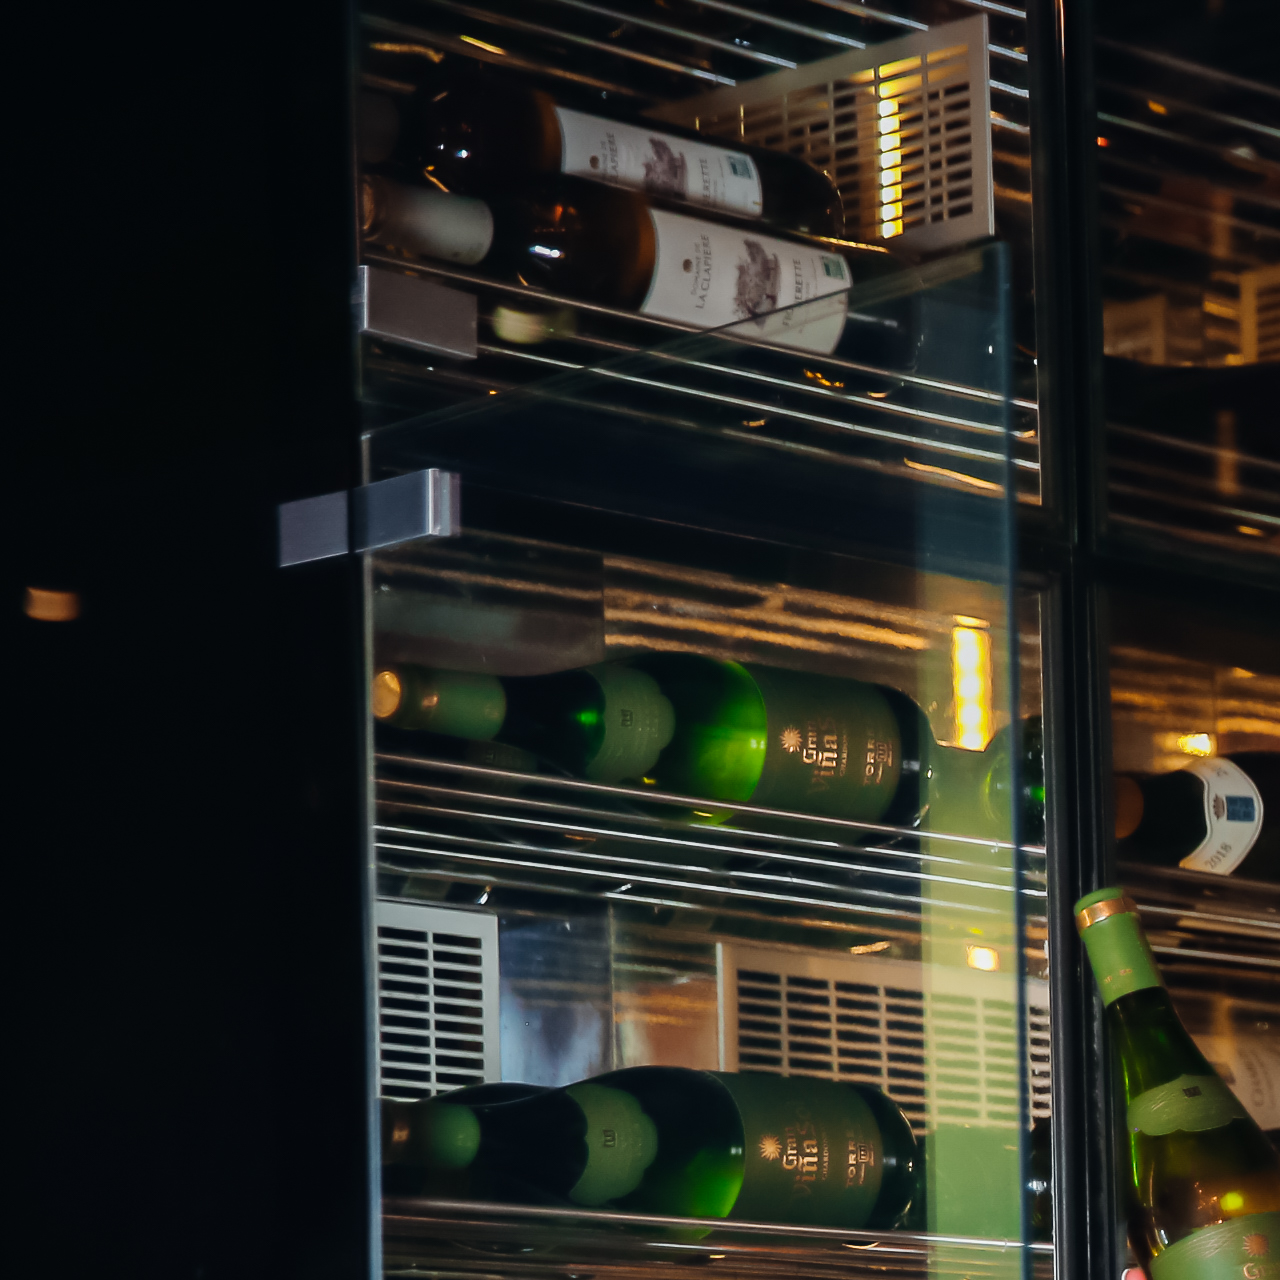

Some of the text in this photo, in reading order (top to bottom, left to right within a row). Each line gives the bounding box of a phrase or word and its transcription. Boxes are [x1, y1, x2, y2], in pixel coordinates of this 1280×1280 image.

[695, 234, 712, 309] LA CLAPIERE
[803, 720, 817, 764] Gran
[782, 1126, 798, 1170] Gran
